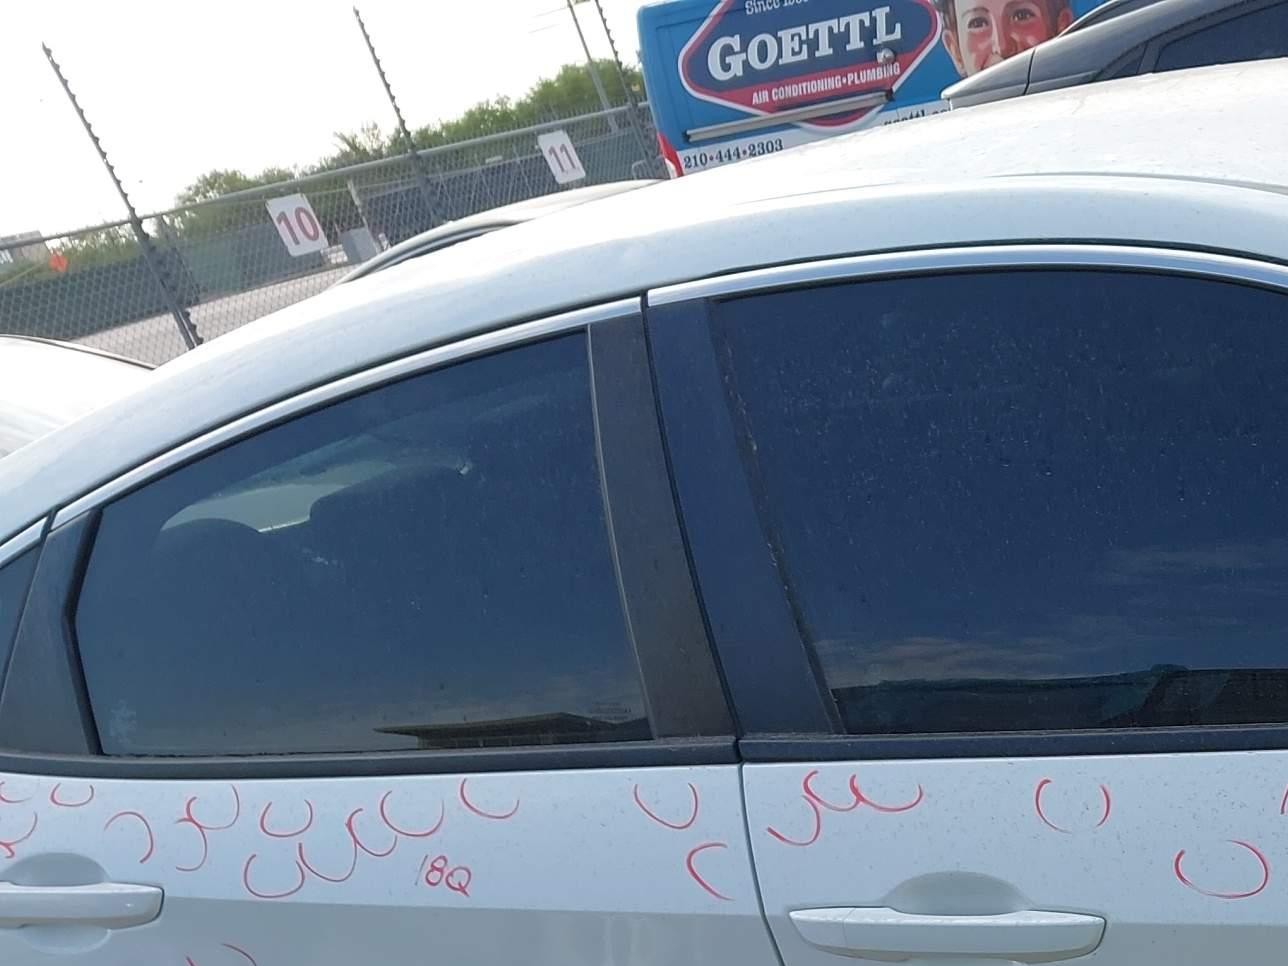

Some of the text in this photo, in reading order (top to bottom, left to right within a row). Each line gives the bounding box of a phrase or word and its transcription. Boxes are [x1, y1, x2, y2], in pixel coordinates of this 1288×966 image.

[708, 6, 902, 81] GOETTL
[752, 92, 769, 105] AIR
[548, 143, 576, 173] 11
[276, 206, 320, 246] 10
